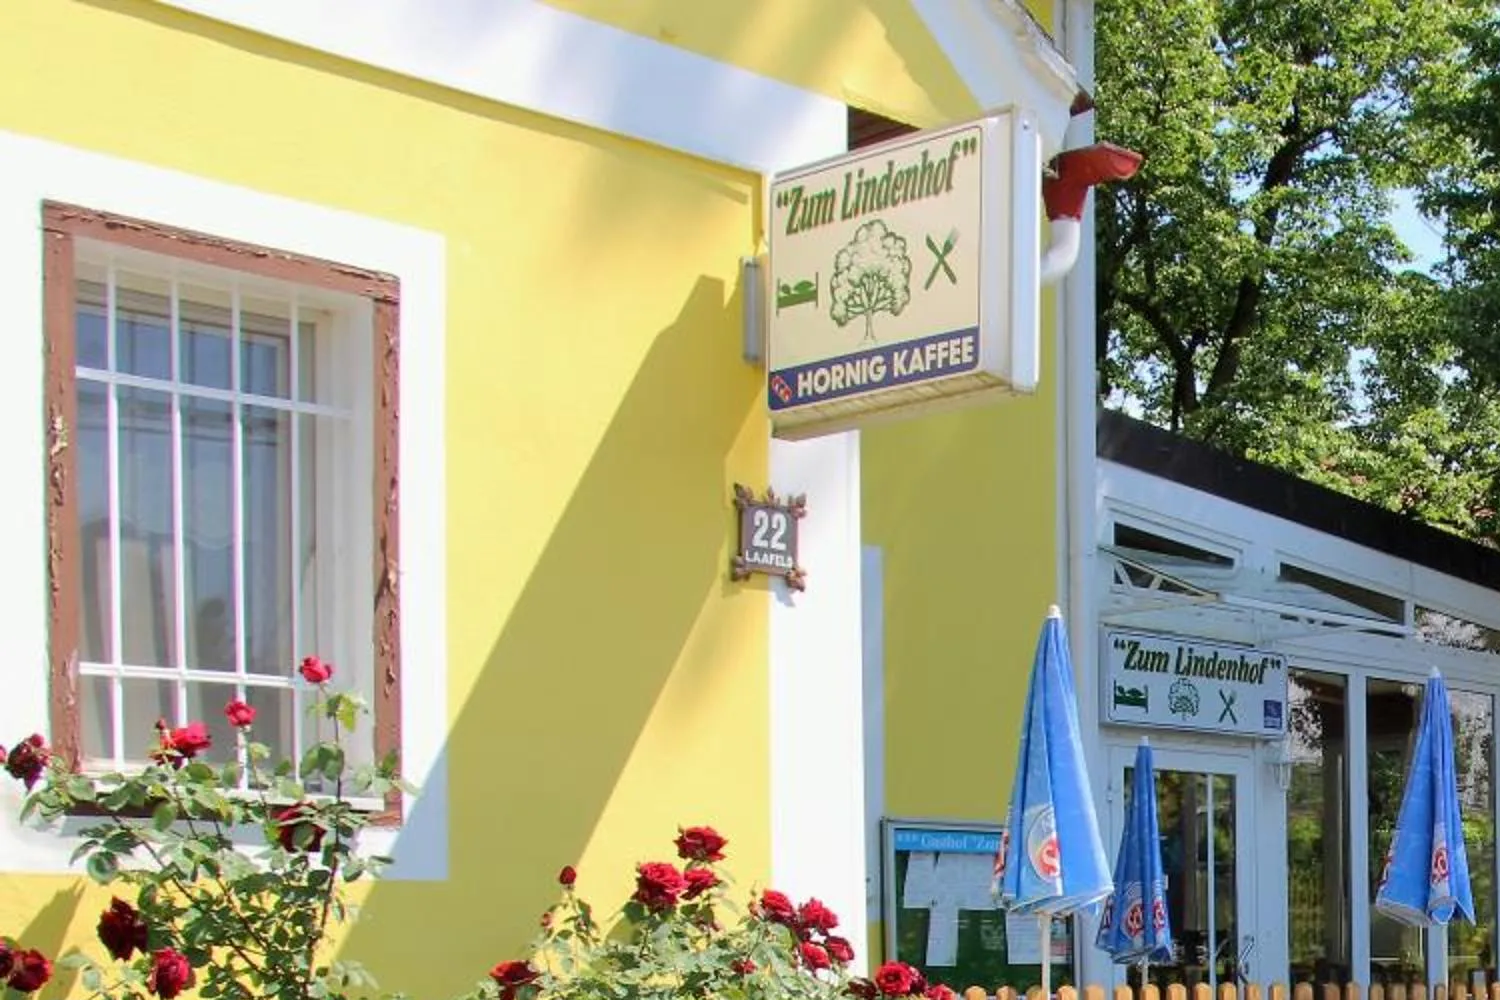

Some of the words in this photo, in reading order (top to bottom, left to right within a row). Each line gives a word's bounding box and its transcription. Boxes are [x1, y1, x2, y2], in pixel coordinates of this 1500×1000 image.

[797, 354, 887, 399] HORNIG
[893, 334, 974, 378] KAFFEE
[752, 509, 787, 550] 22
